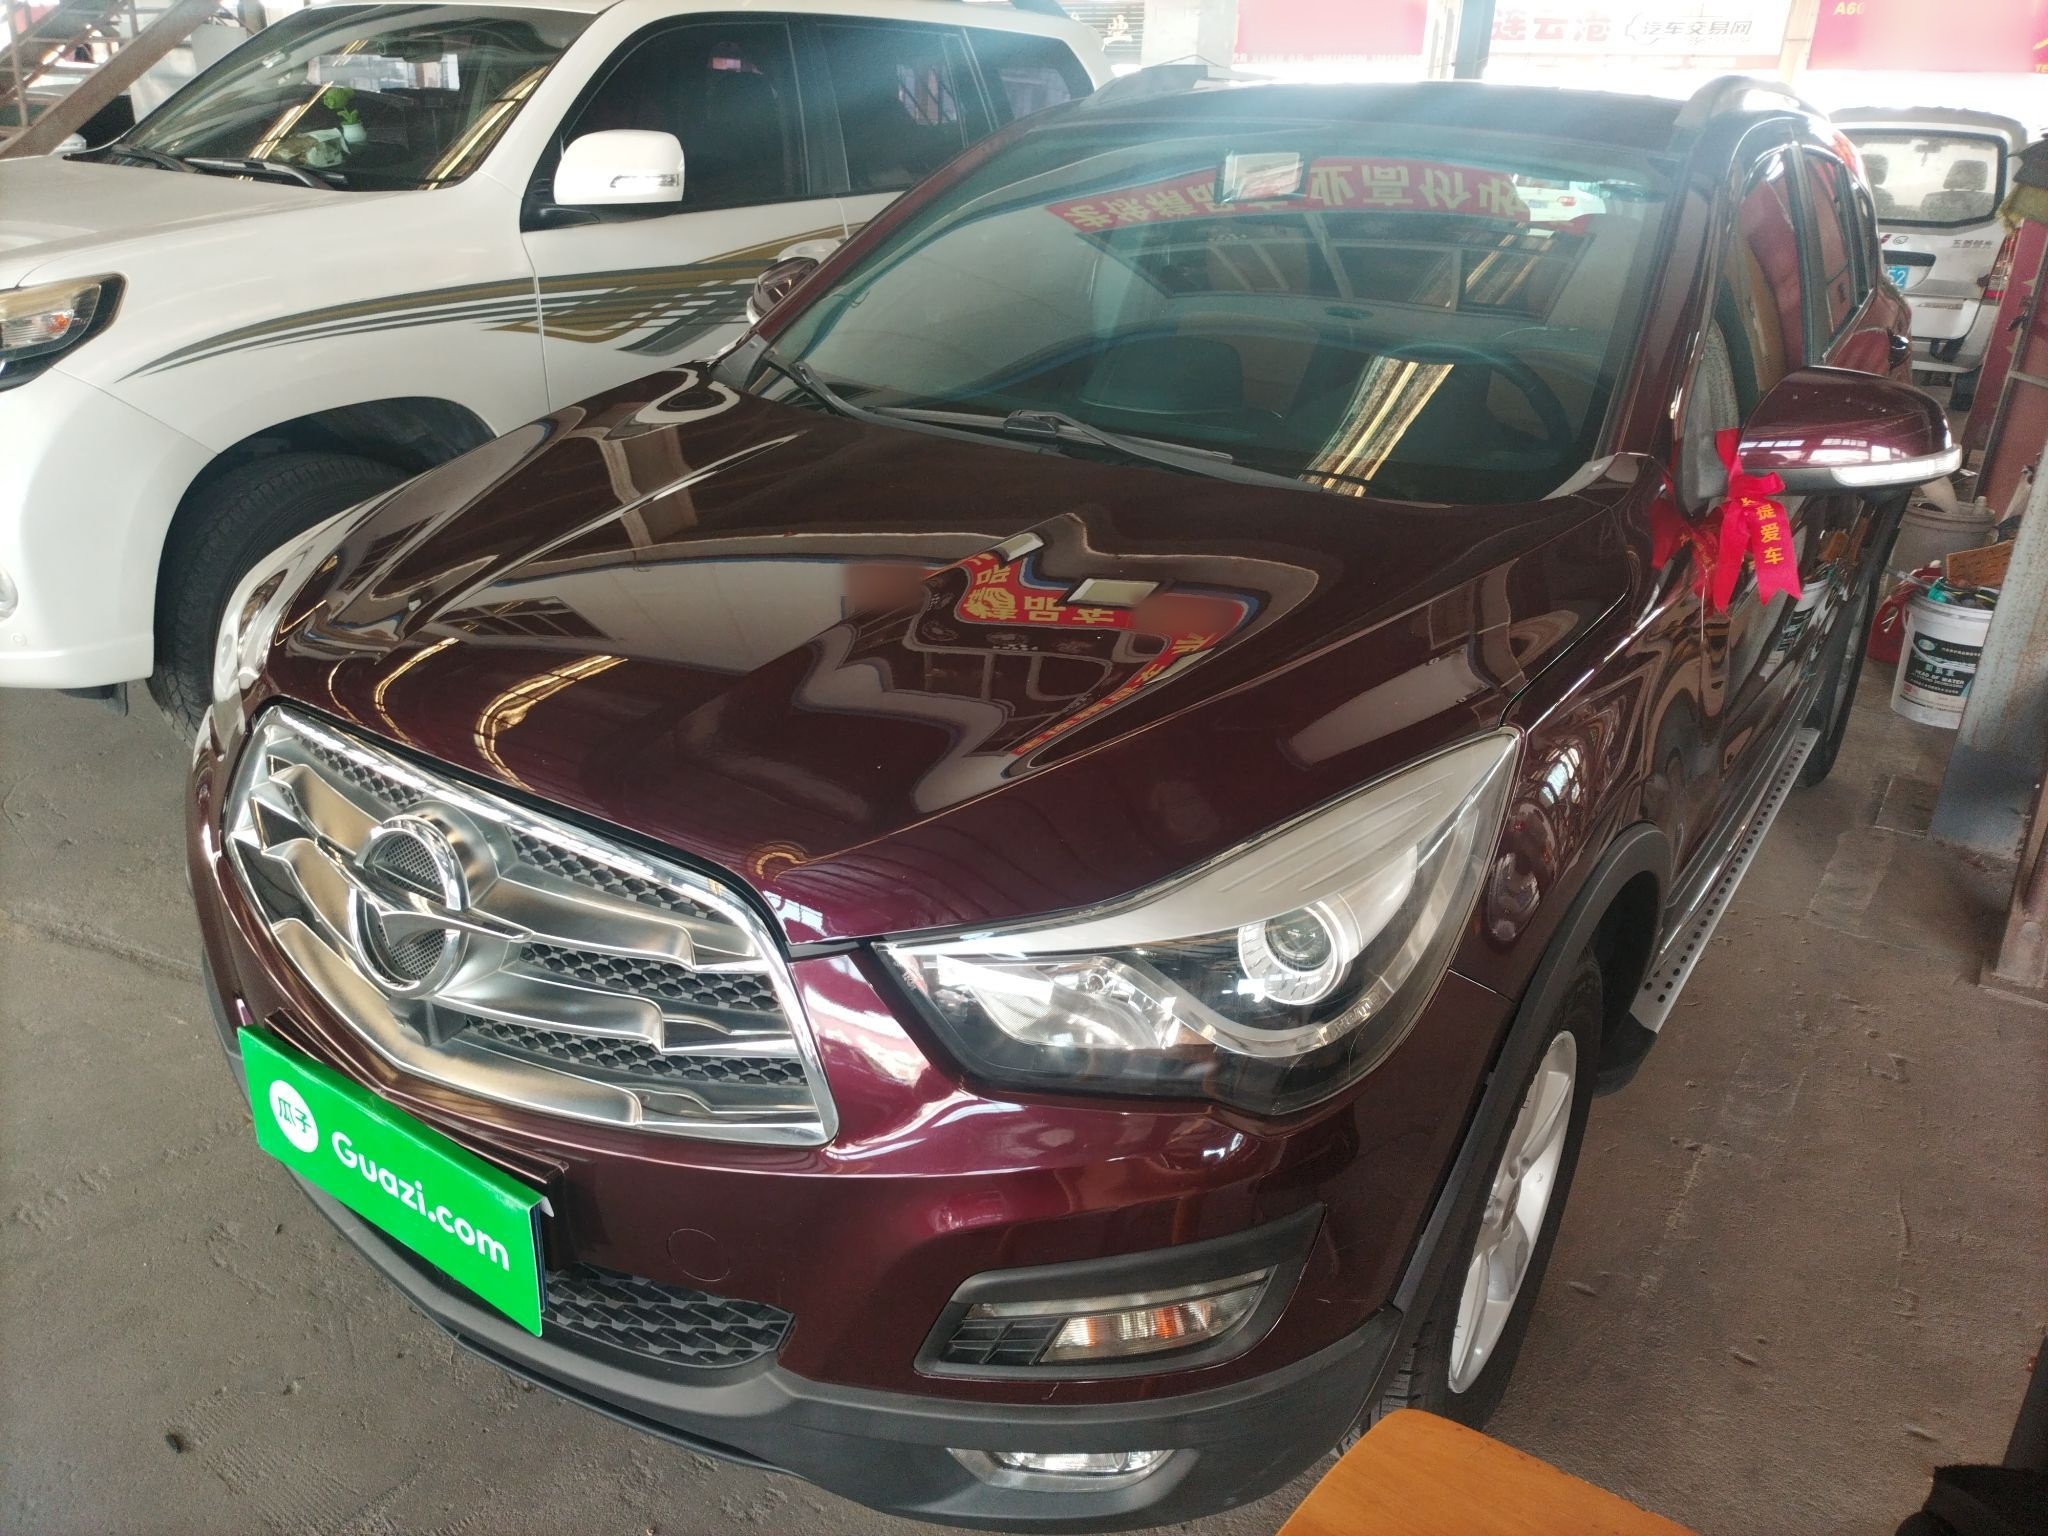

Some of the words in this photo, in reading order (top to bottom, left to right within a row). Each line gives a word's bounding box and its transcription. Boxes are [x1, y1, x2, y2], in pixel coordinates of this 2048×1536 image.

[1643, 20, 1753, 35] 汽车交易网
[1941, 676, 1965, 686] WATER
[277, 1092, 313, 1134] 瓜子
[331, 1130, 511, 1272] Guazi.com
